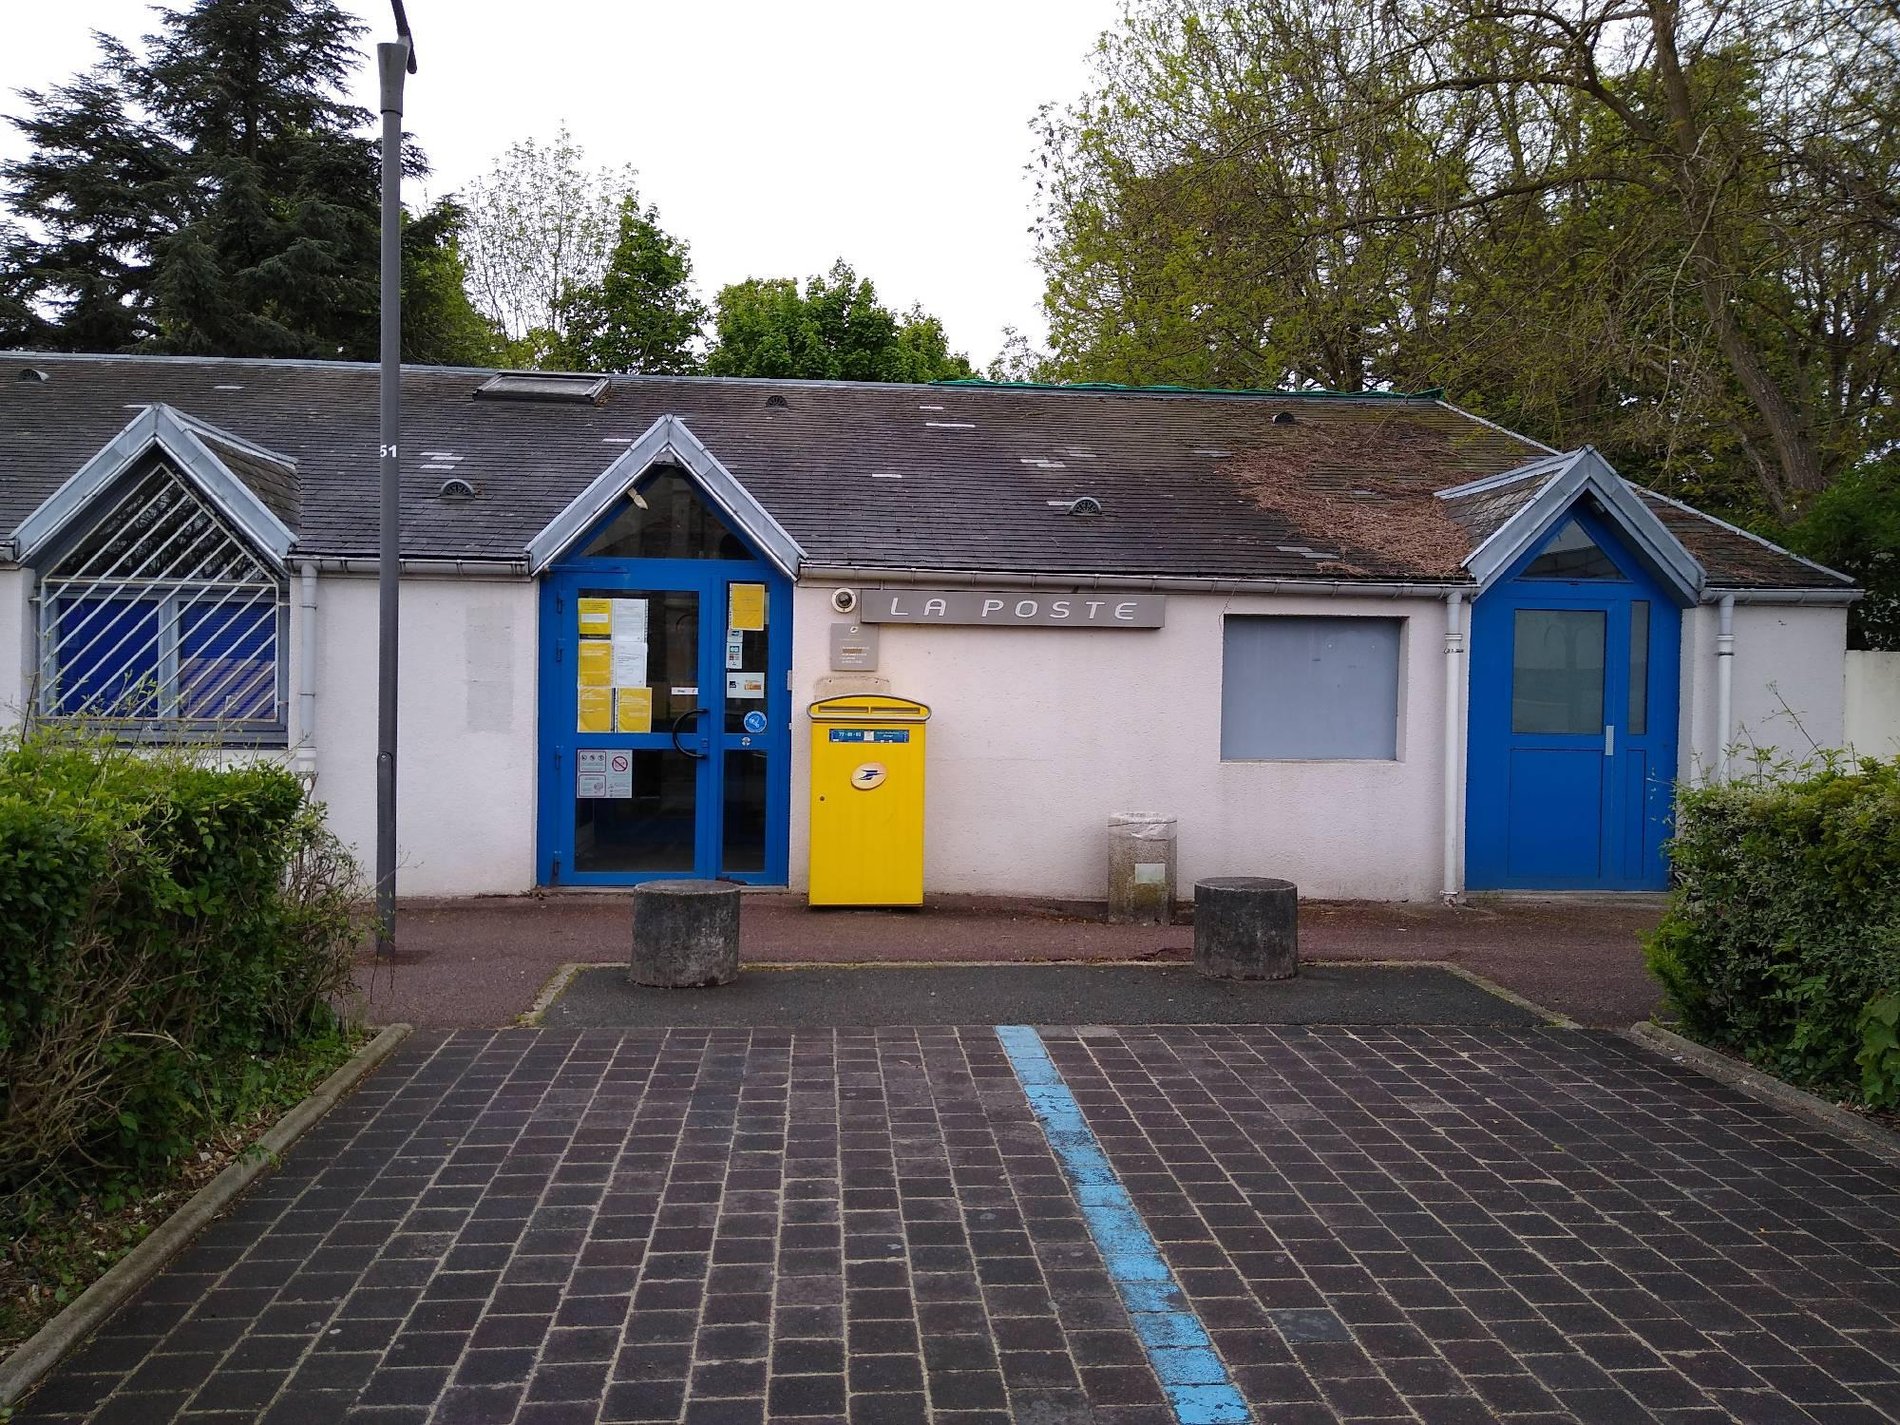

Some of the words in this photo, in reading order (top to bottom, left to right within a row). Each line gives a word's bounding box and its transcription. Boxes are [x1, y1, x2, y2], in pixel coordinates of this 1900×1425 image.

[379, 444, 397, 458] 51
[890, 597, 947, 616] LA
[981, 599, 1138, 620] POSTE
